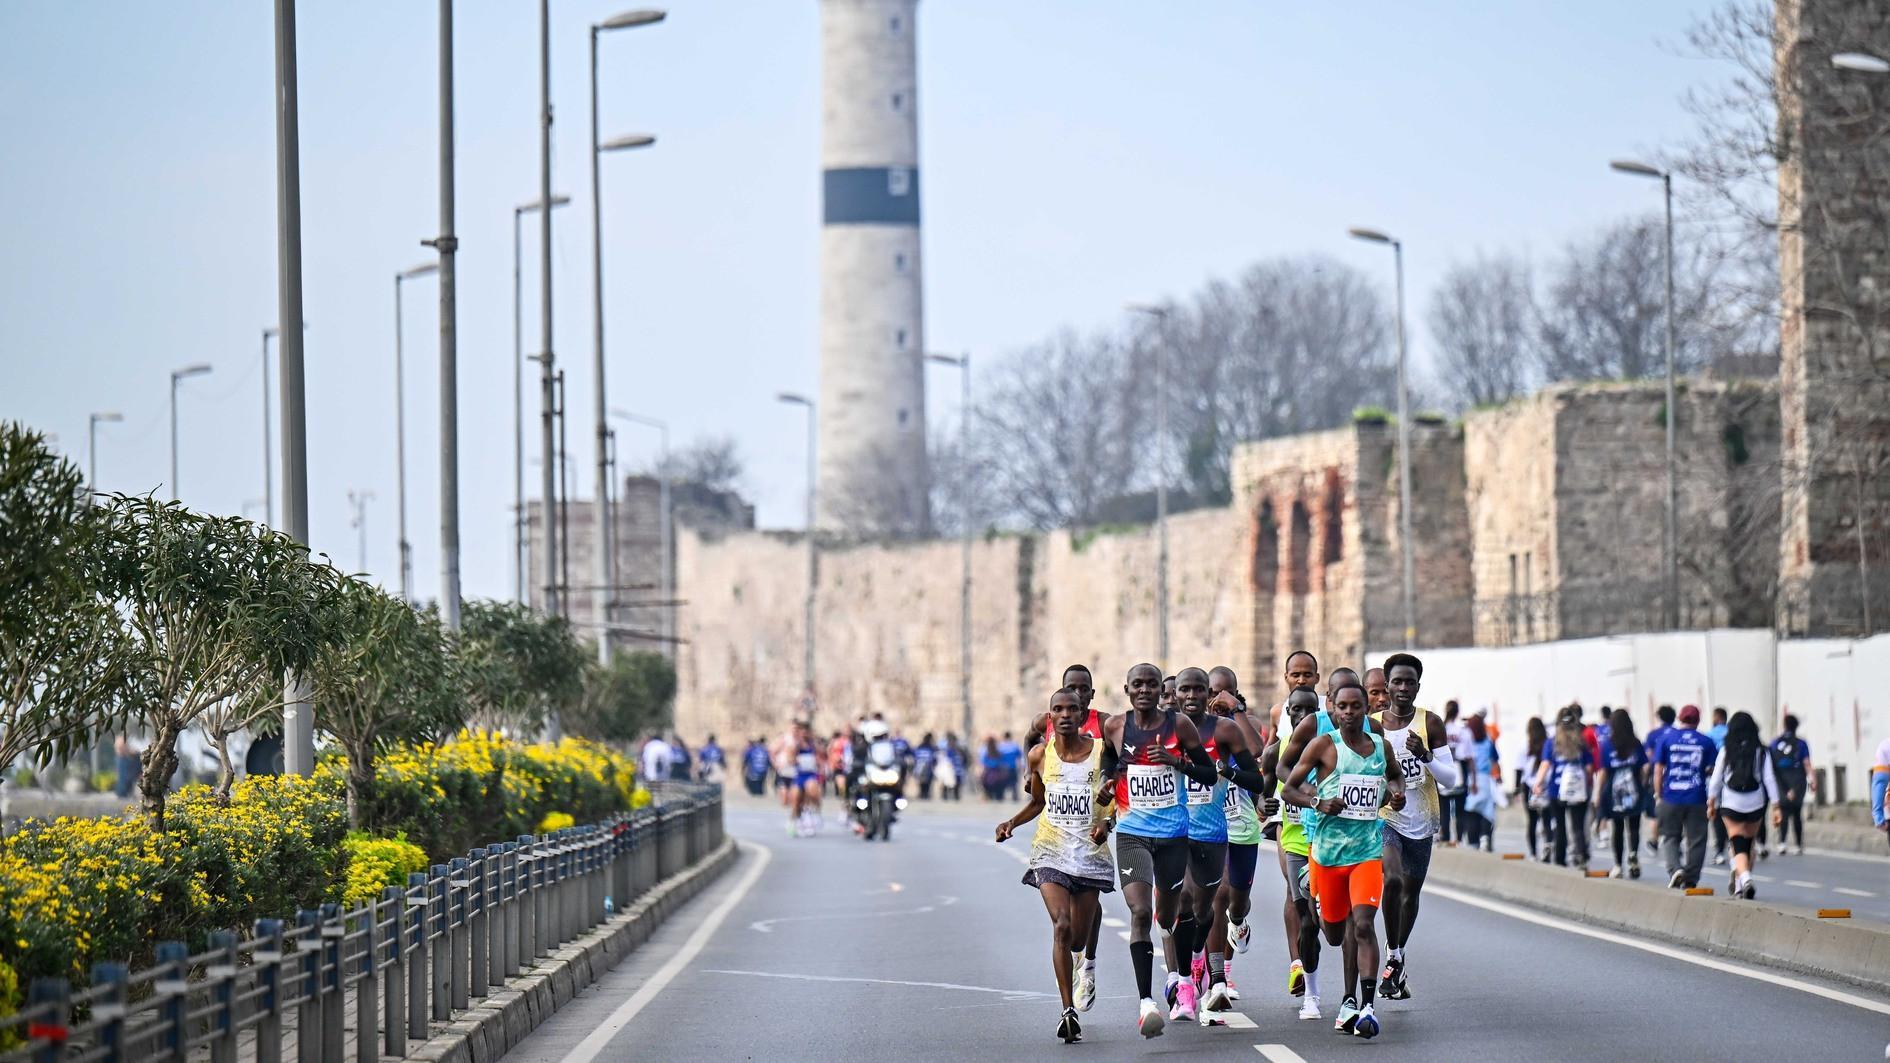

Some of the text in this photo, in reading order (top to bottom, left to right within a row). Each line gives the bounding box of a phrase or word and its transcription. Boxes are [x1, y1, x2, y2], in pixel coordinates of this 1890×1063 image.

[1398, 758, 1421, 778] SES
[1130, 773, 1175, 797] CHARLES
[1343, 785, 1379, 808] KOECH
[1047, 792, 1091, 816] SHADRACK
